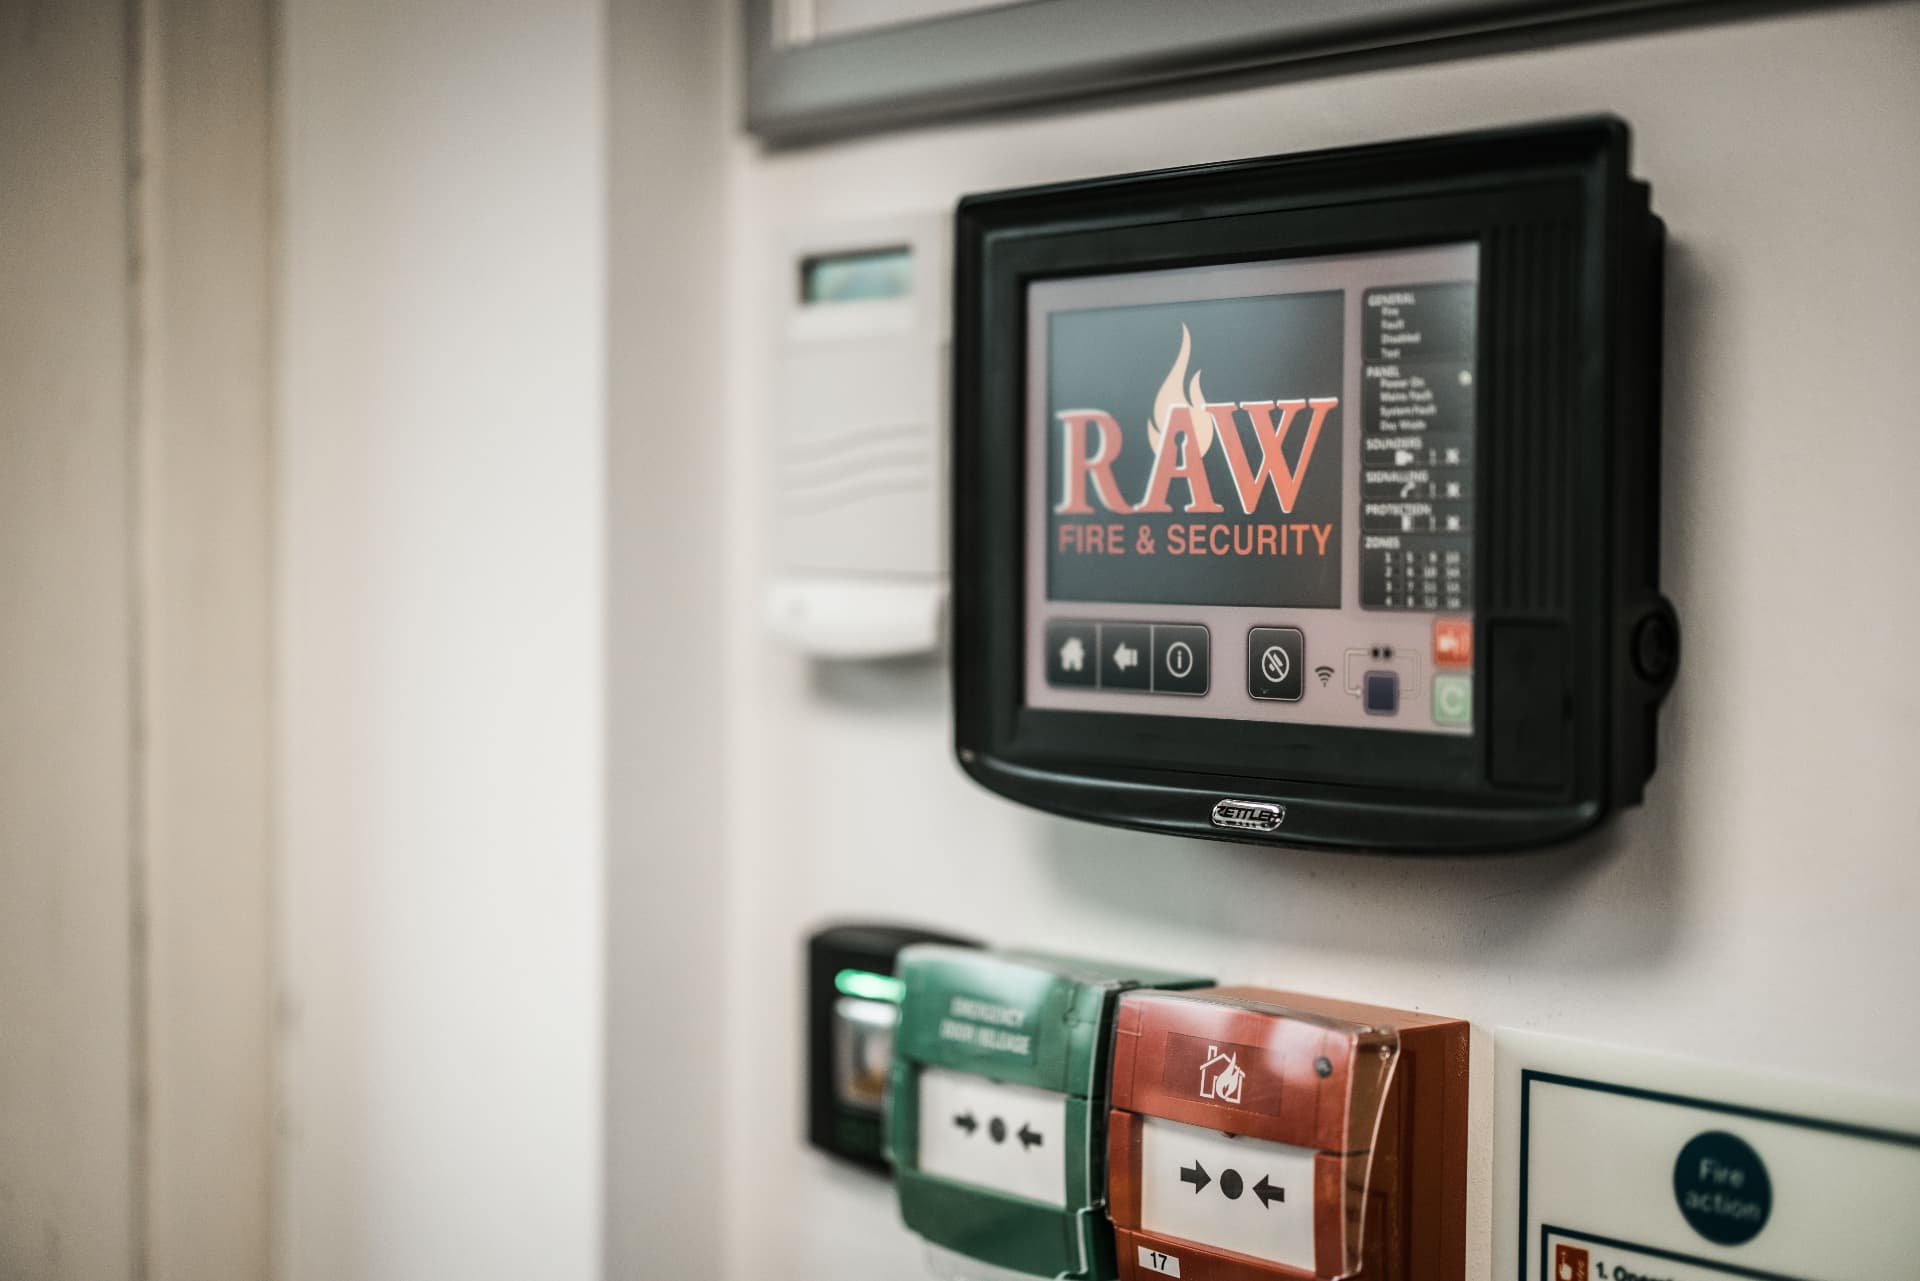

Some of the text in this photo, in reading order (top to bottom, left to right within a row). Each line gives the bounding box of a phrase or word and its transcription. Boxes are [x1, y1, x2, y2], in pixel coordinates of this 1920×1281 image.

[1367, 292, 1416, 307] GENERAL
[1366, 365, 1399, 378] PANEL
[1054, 397, 1338, 515] RAW
[1365, 503, 1433, 516] PROTECTION
[1058, 523, 1333, 556] FIRE & SECURITY
[1365, 536, 1401, 549] ZONES
[1699, 1157, 1746, 1188] Fire
[1684, 1189, 1761, 1220] action
[1150, 1252, 1167, 1271] 17
